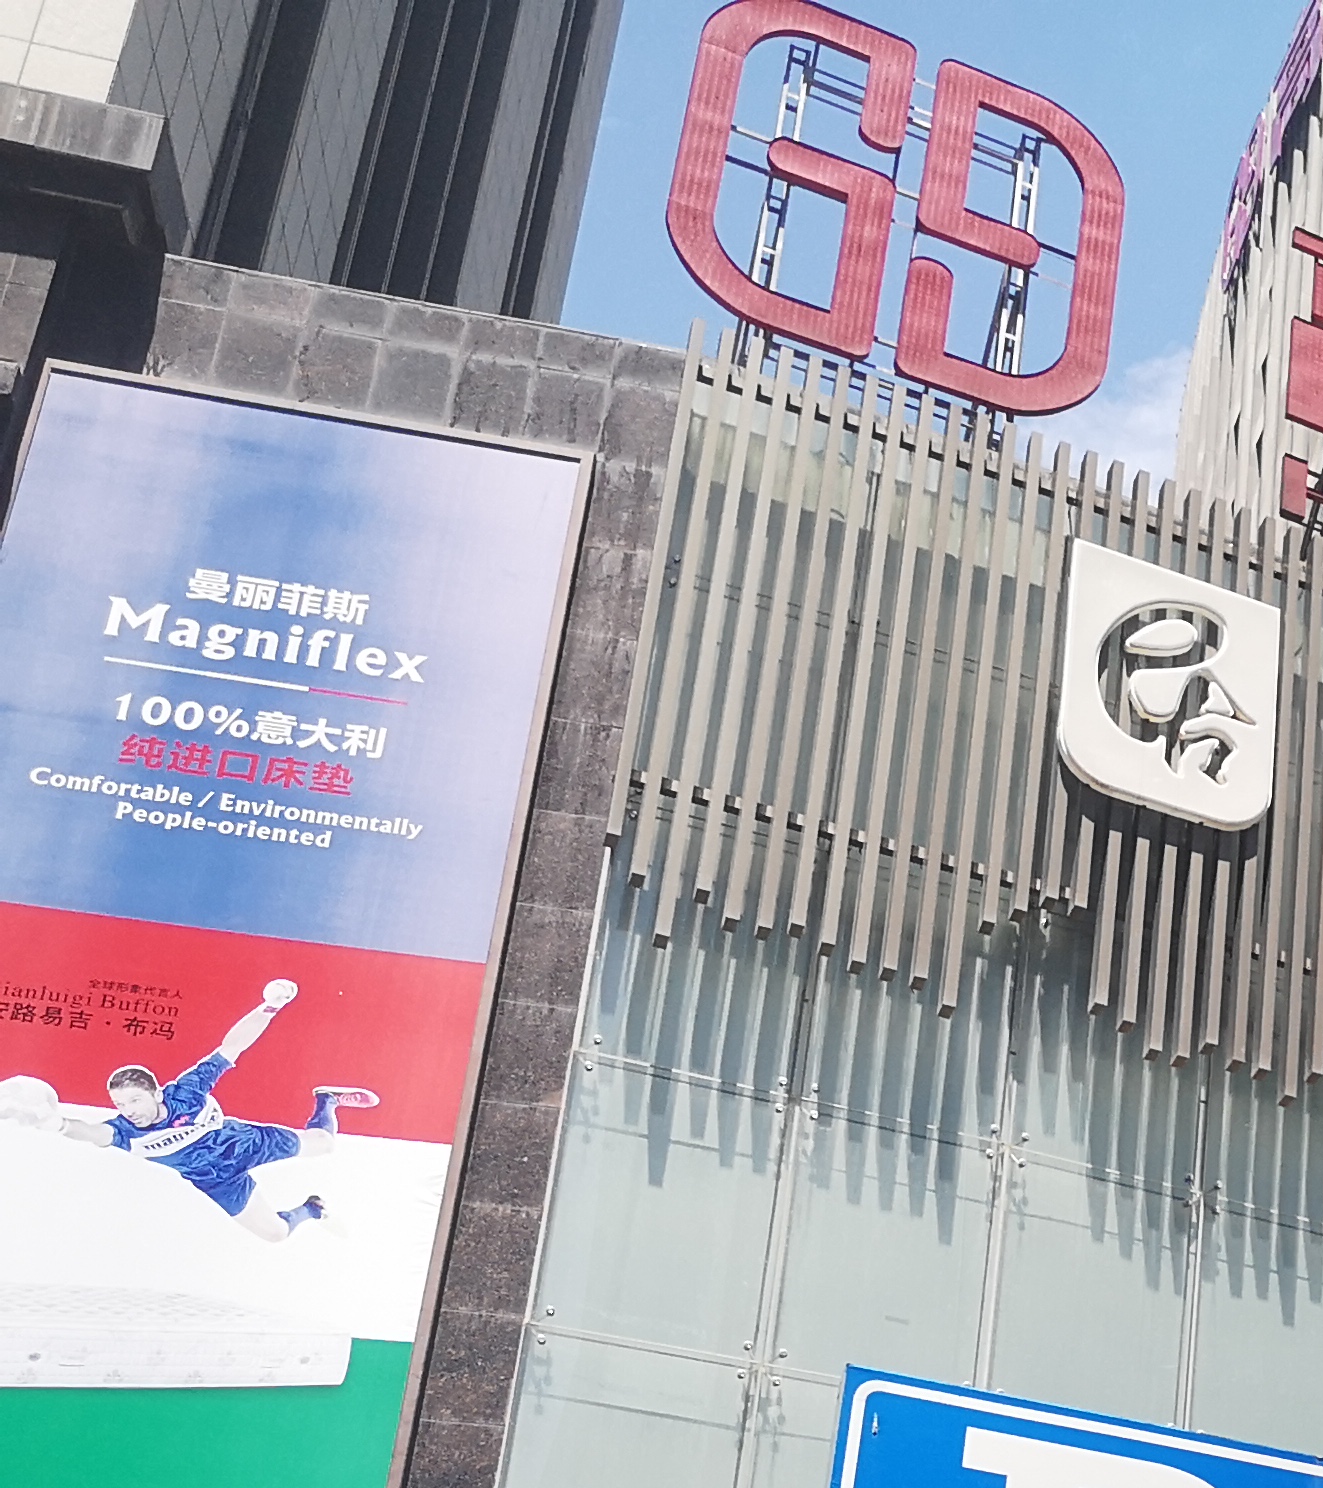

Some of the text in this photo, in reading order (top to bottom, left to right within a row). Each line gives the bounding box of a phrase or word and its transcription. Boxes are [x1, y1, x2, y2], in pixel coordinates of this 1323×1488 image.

[186, 567, 371, 625] 曼丽菲斯
[103, 595, 428, 683] Magniflex
[113, 692, 387, 759] 100%意大利
[117, 733, 355, 797] 纯进口床垫
[29, 766, 194, 806] Comfortable
[218, 793, 423, 840] Environmentally
[114, 805, 332, 850] People-oriented
[0, 981, 180, 1018] ianluigi Buffon
